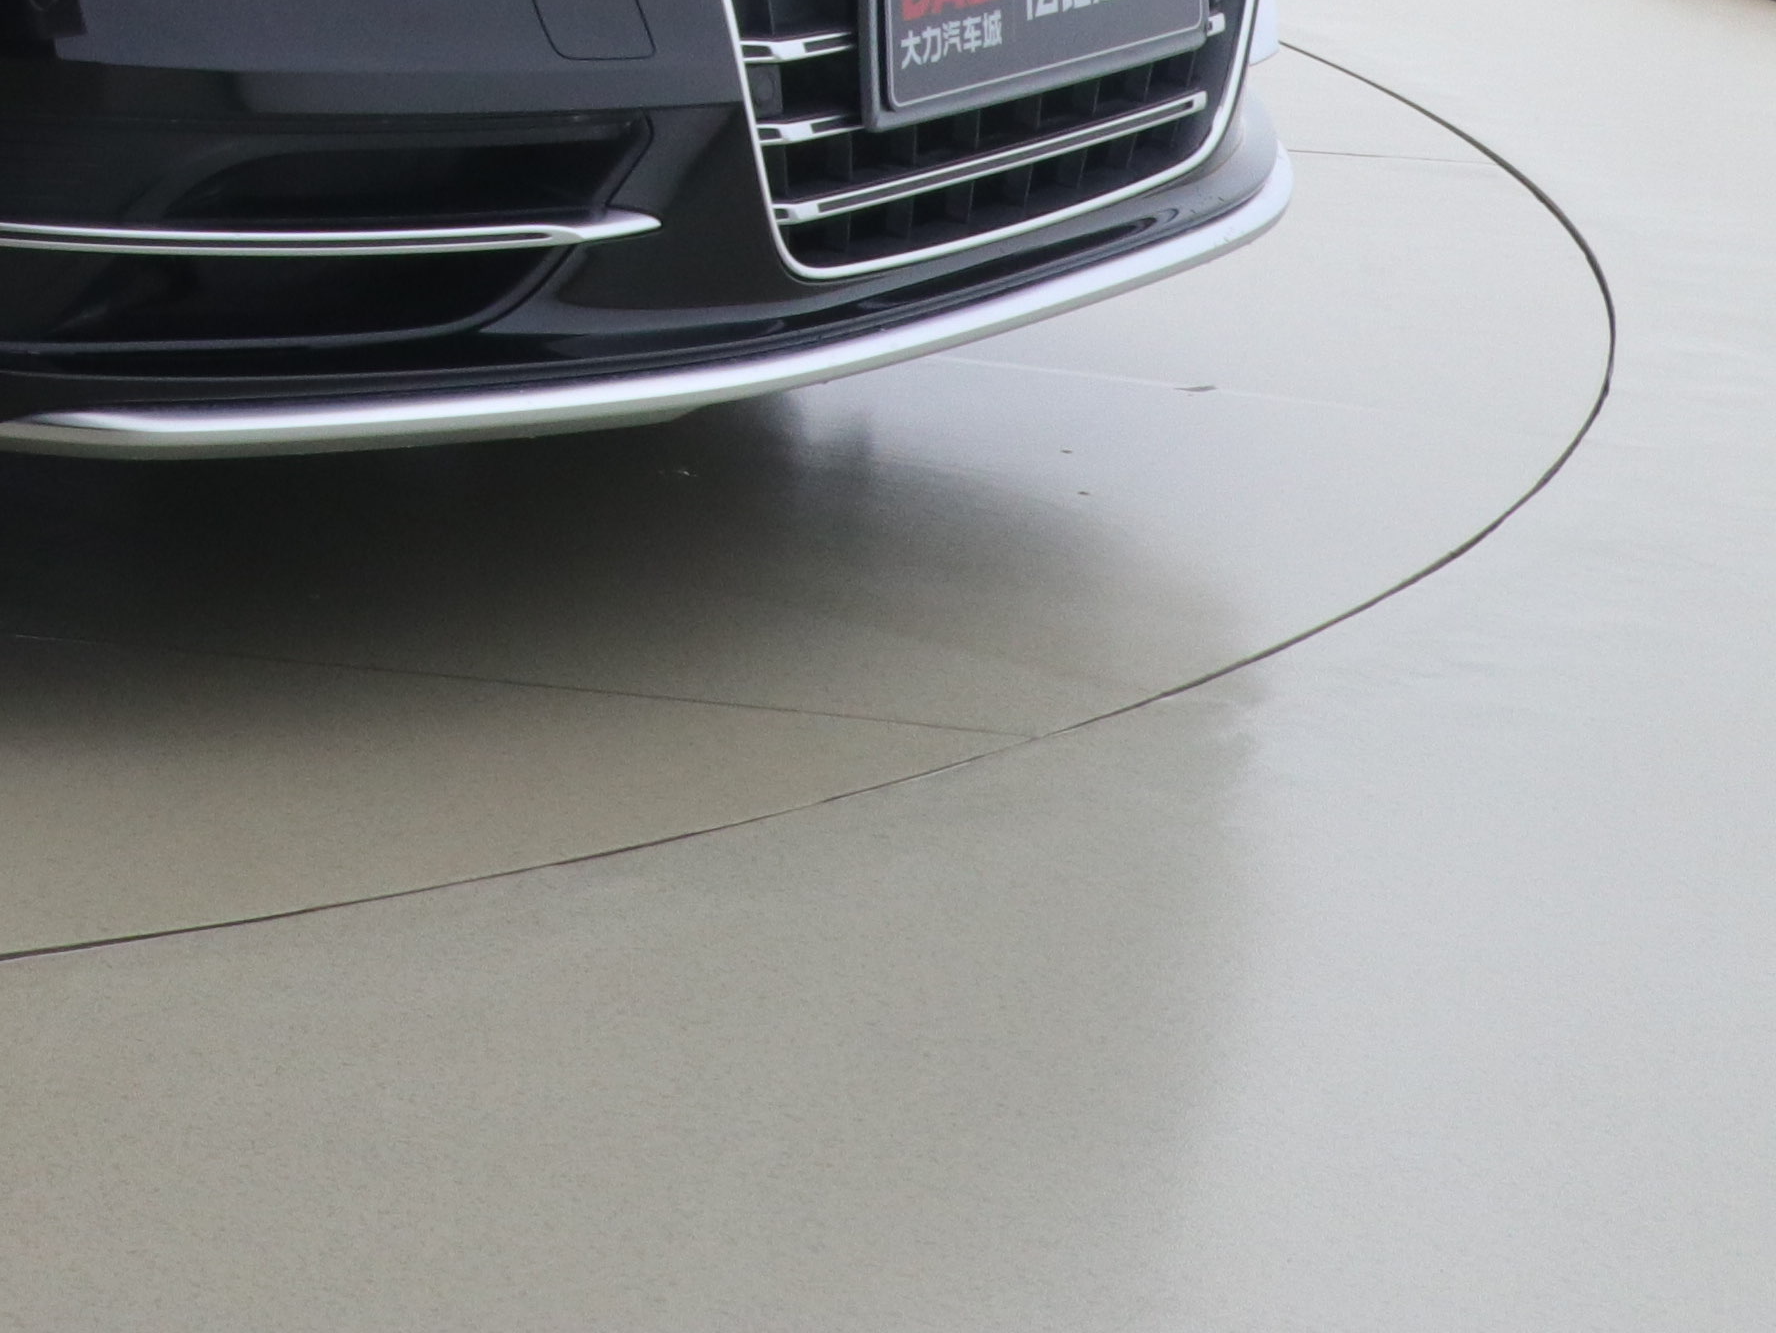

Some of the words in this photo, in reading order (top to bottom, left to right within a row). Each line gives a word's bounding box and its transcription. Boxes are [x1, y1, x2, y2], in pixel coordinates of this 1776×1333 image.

[901, 10, 1003, 70] 大力汽车城
